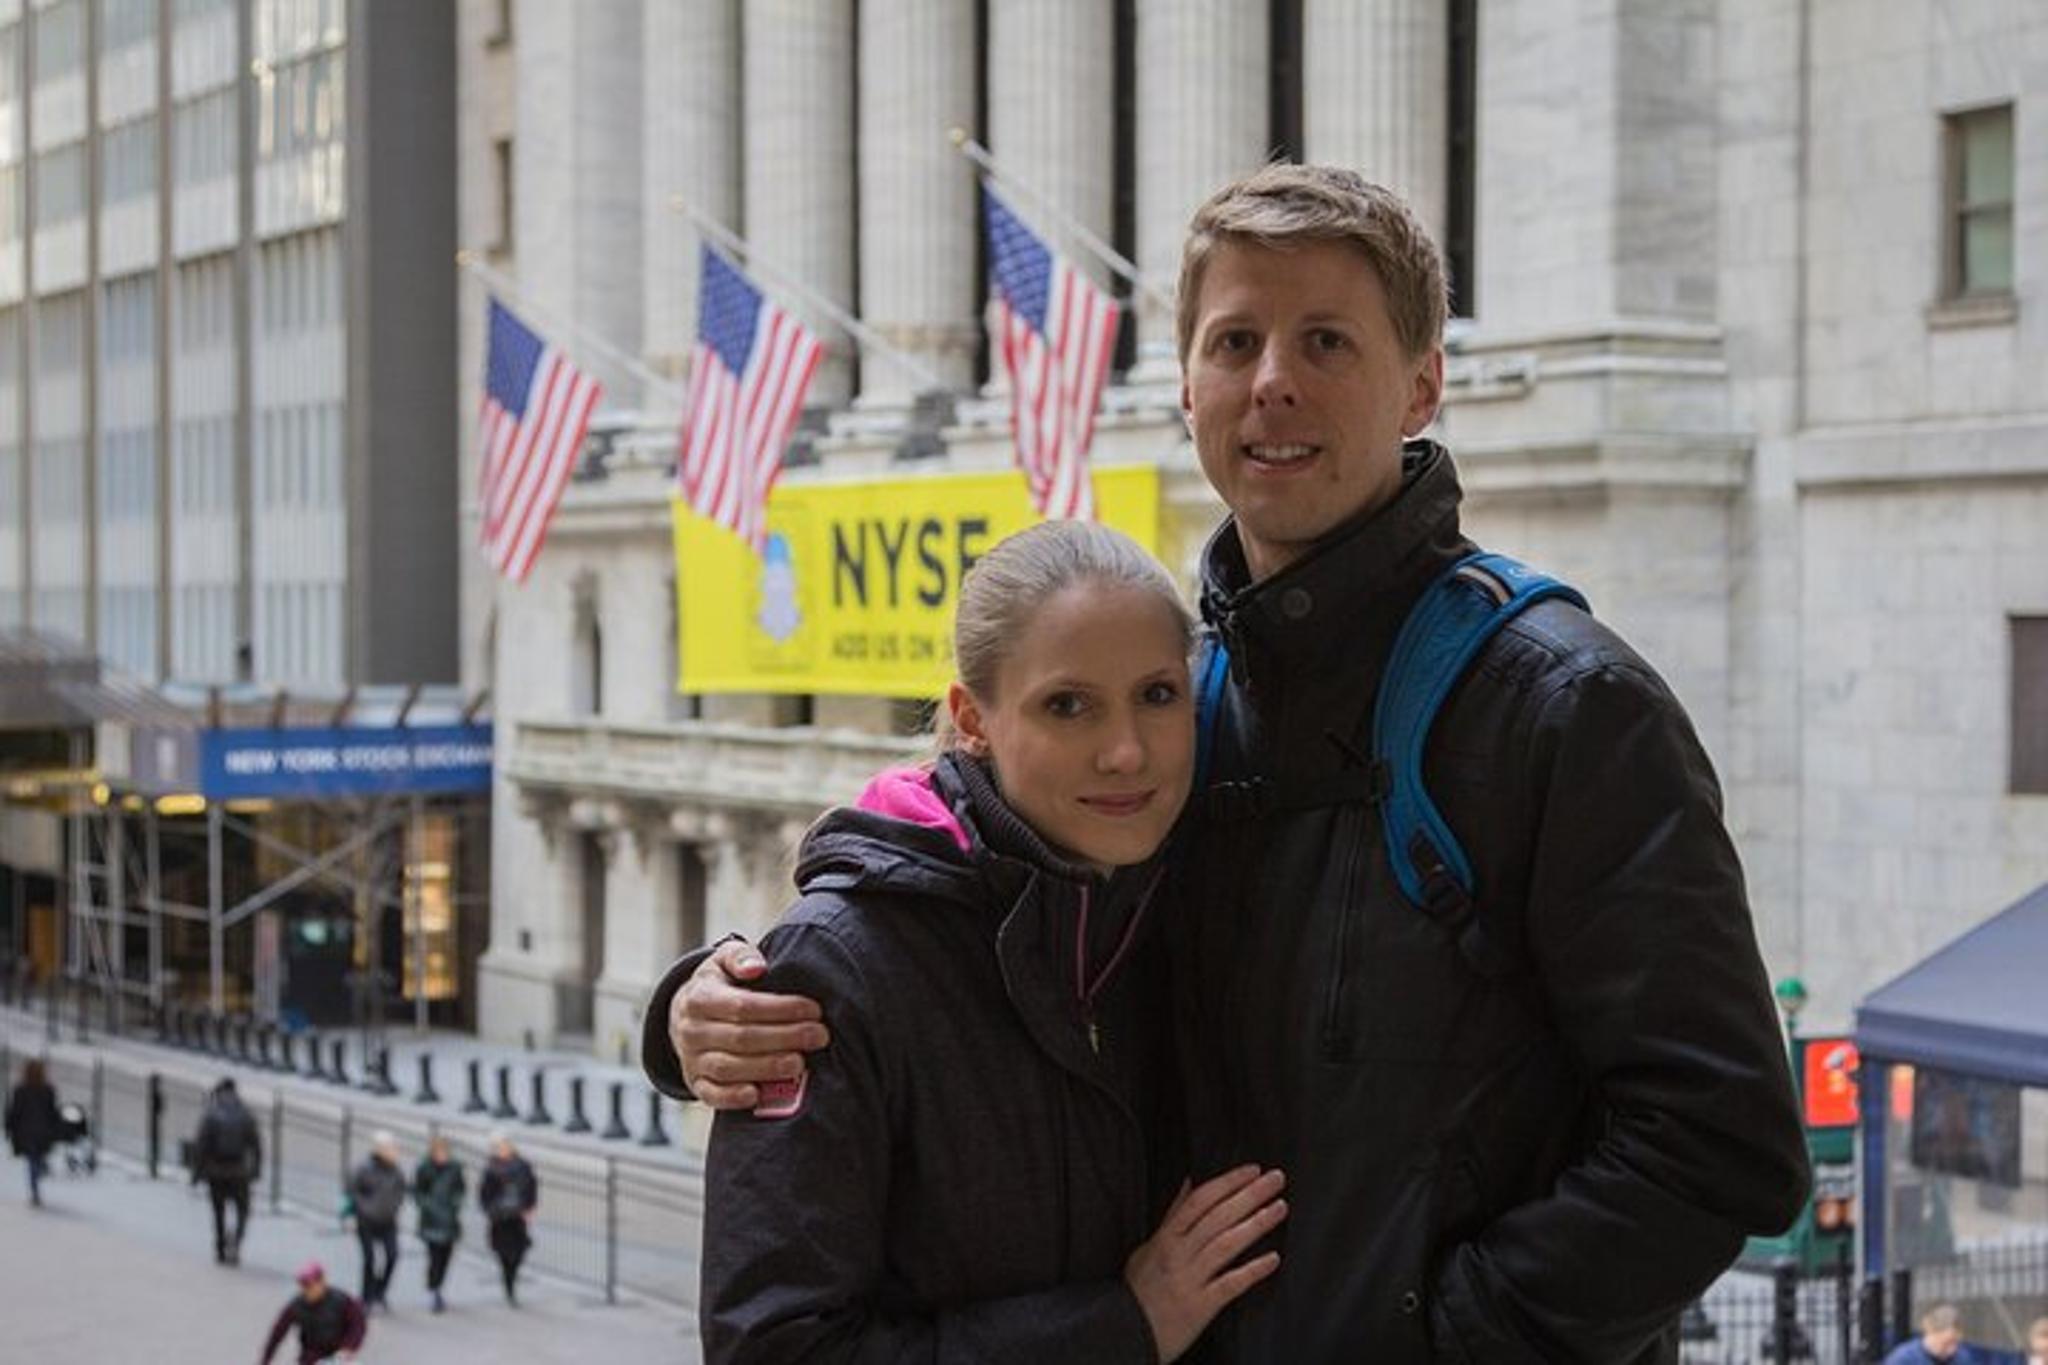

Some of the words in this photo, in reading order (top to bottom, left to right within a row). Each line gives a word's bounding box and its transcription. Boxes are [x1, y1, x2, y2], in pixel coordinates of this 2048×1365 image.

[226, 749, 276, 775] NEW
[280, 748, 337, 773] YORK
[340, 746, 410, 771] STOCK
